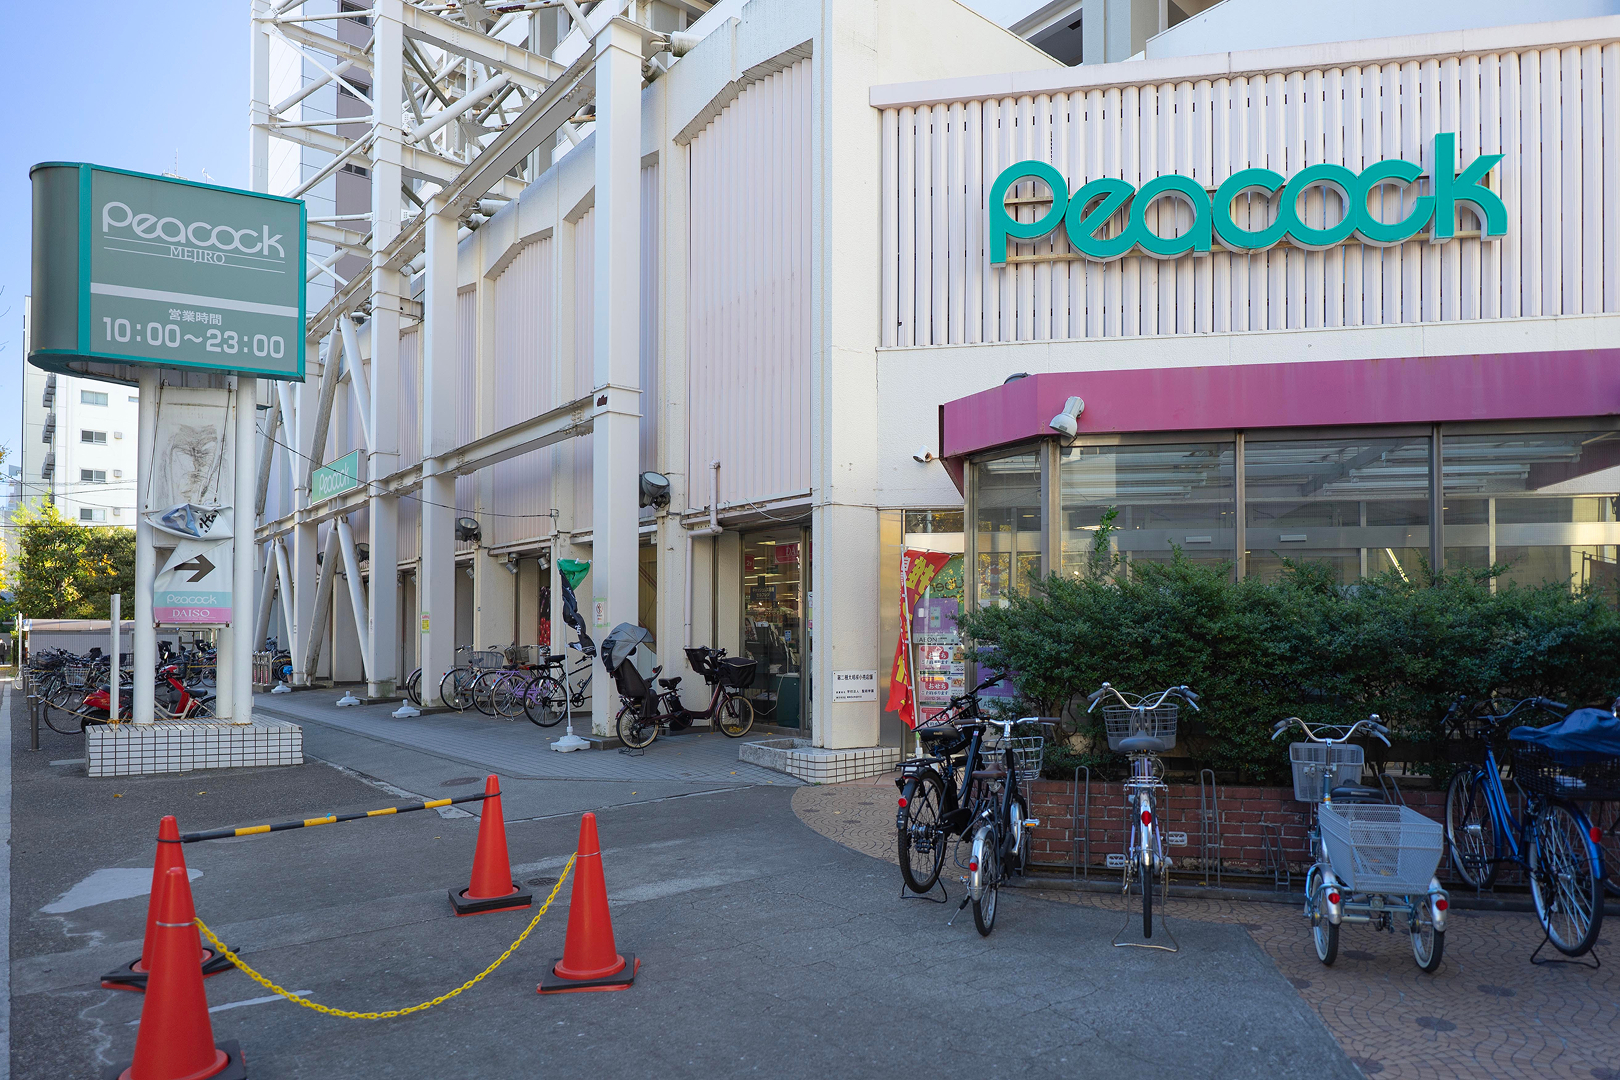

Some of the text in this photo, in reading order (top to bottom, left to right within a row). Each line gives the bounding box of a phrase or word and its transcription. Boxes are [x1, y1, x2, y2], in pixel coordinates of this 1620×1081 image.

[989, 132, 1508, 267] Peacock
[102, 201, 285, 258] Peacock
[169, 246, 226, 265] MEJIRO
[168, 308, 222, 326] 営業時間
[318, 462, 350, 496] Peacock
[166, 594, 217, 604] Peacock
[172, 609, 210, 617] DAISO
[928, 682, 947, 690] おせち
